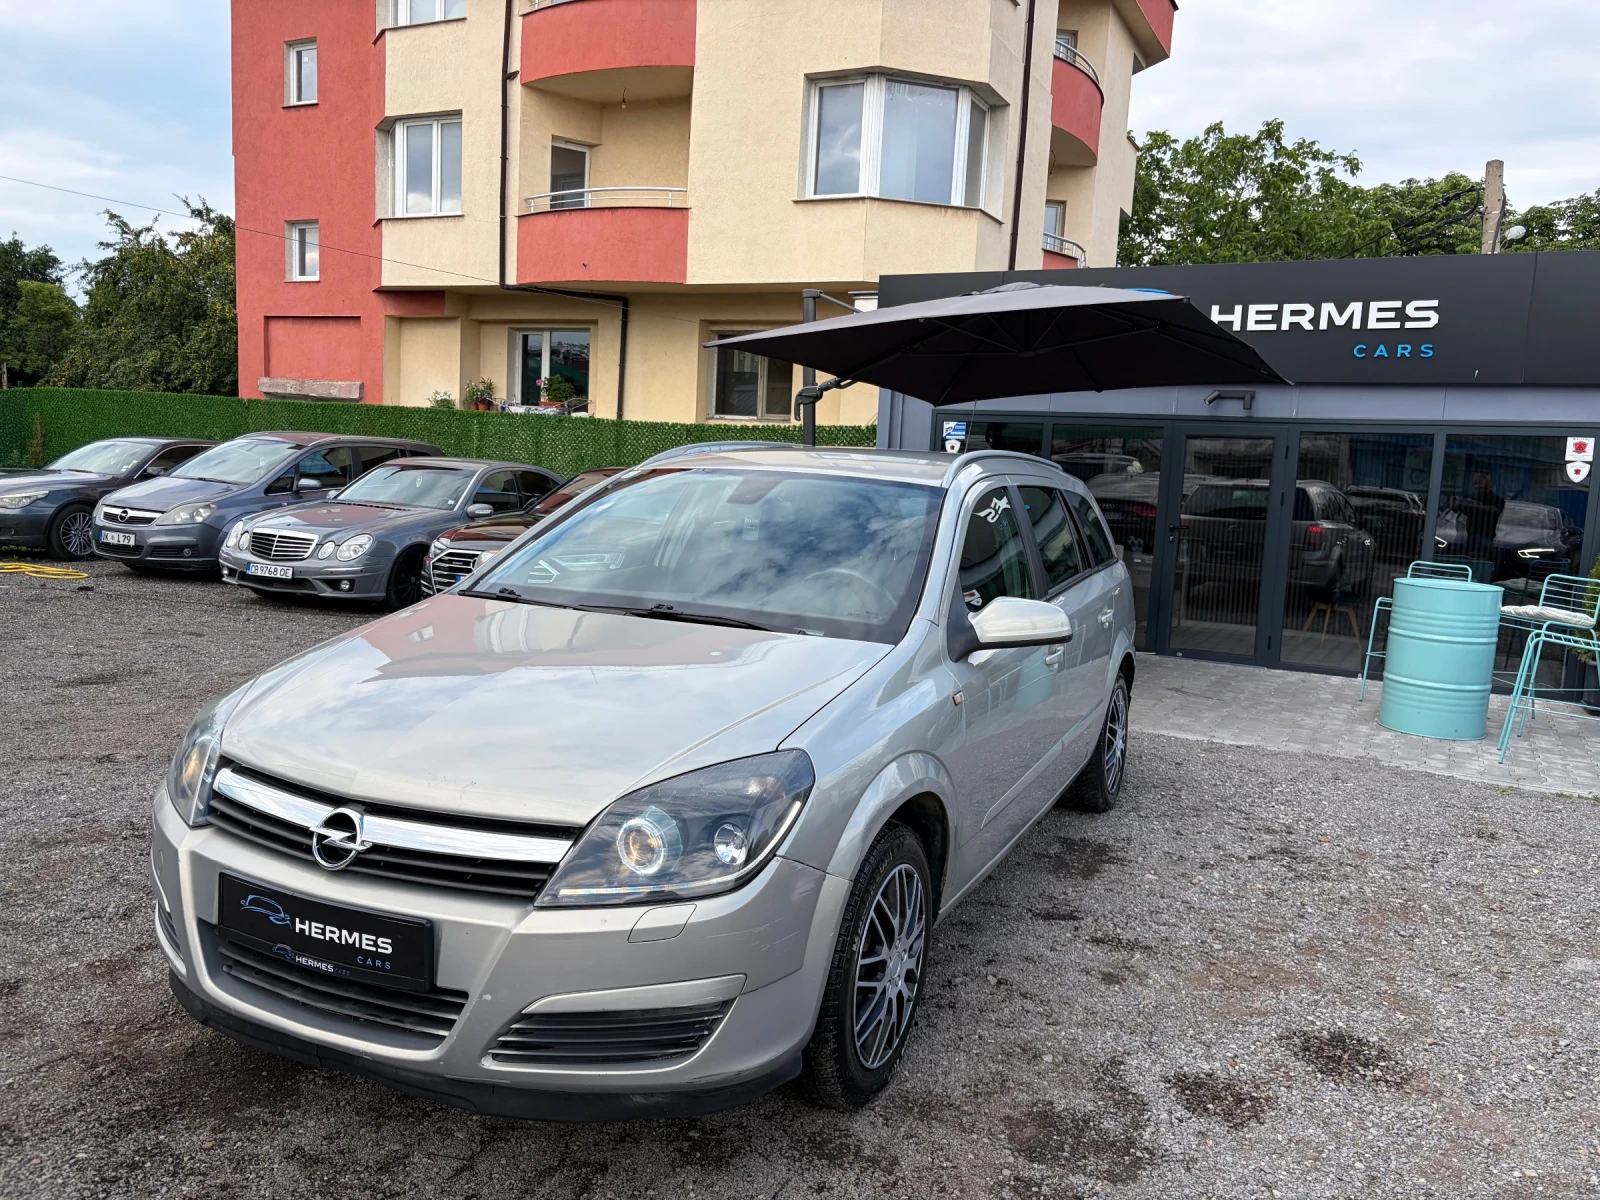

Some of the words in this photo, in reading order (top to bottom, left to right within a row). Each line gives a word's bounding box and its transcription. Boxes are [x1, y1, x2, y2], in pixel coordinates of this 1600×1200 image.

[1210, 299, 1440, 332] HERMES
[1353, 344, 1435, 358] CARS
[294, 917, 393, 954] HERMES
[294, 955, 334, 973] HERMES
[356, 955, 391, 970] CARS
